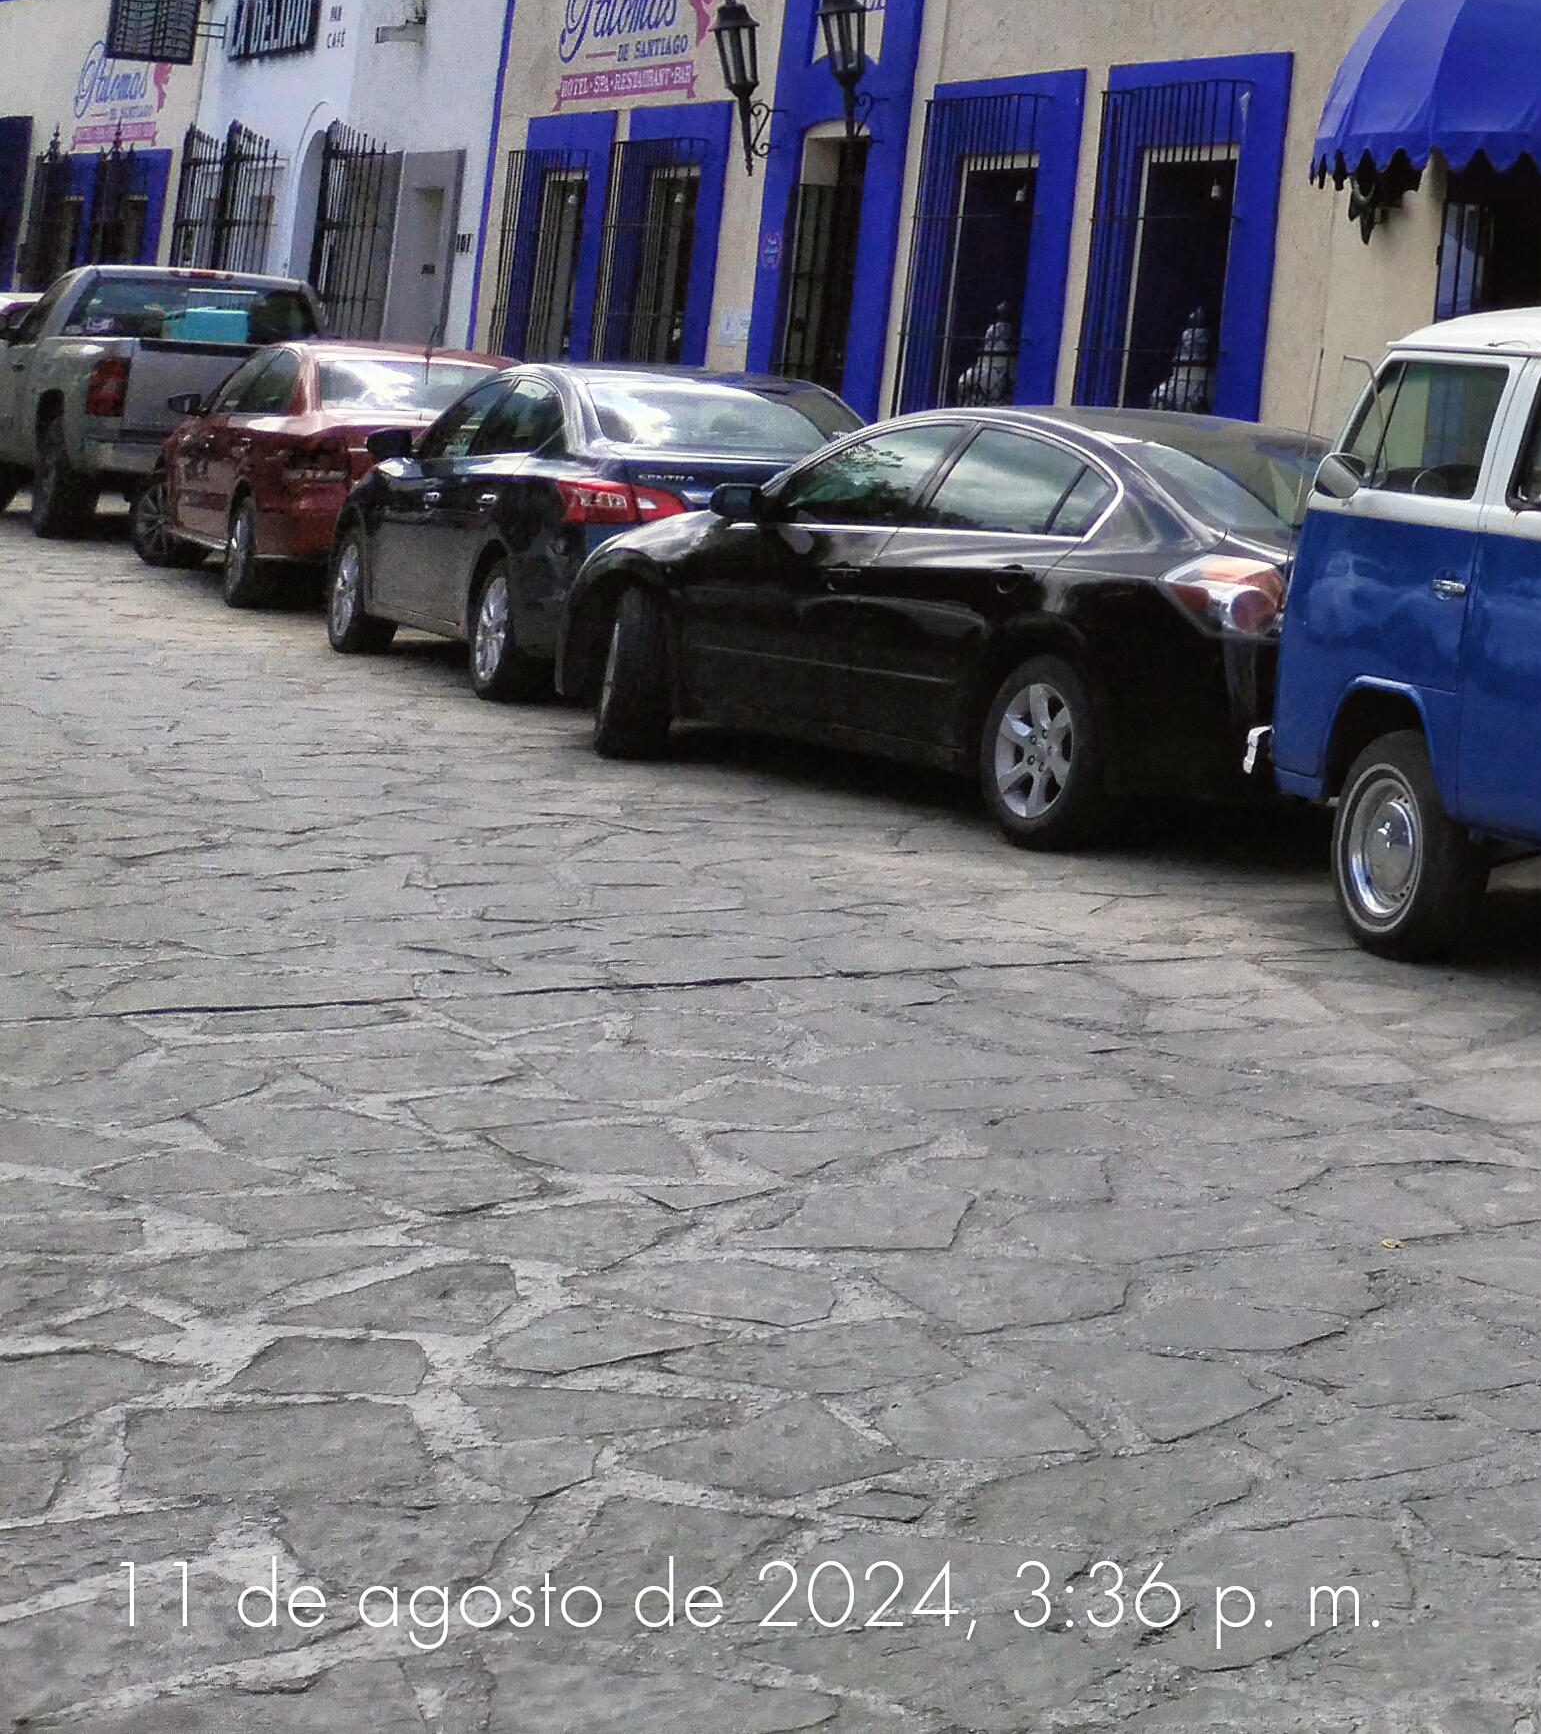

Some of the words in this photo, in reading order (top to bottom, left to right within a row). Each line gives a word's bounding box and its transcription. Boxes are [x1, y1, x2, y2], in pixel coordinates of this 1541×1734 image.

[617, 43, 631, 63] DE
[635, 34, 689, 59] SANTIAGO
[561, 77, 588, 98] HOTEL
[593, 75, 610, 94] SPA
[673, 65, 692, 84] BAR
